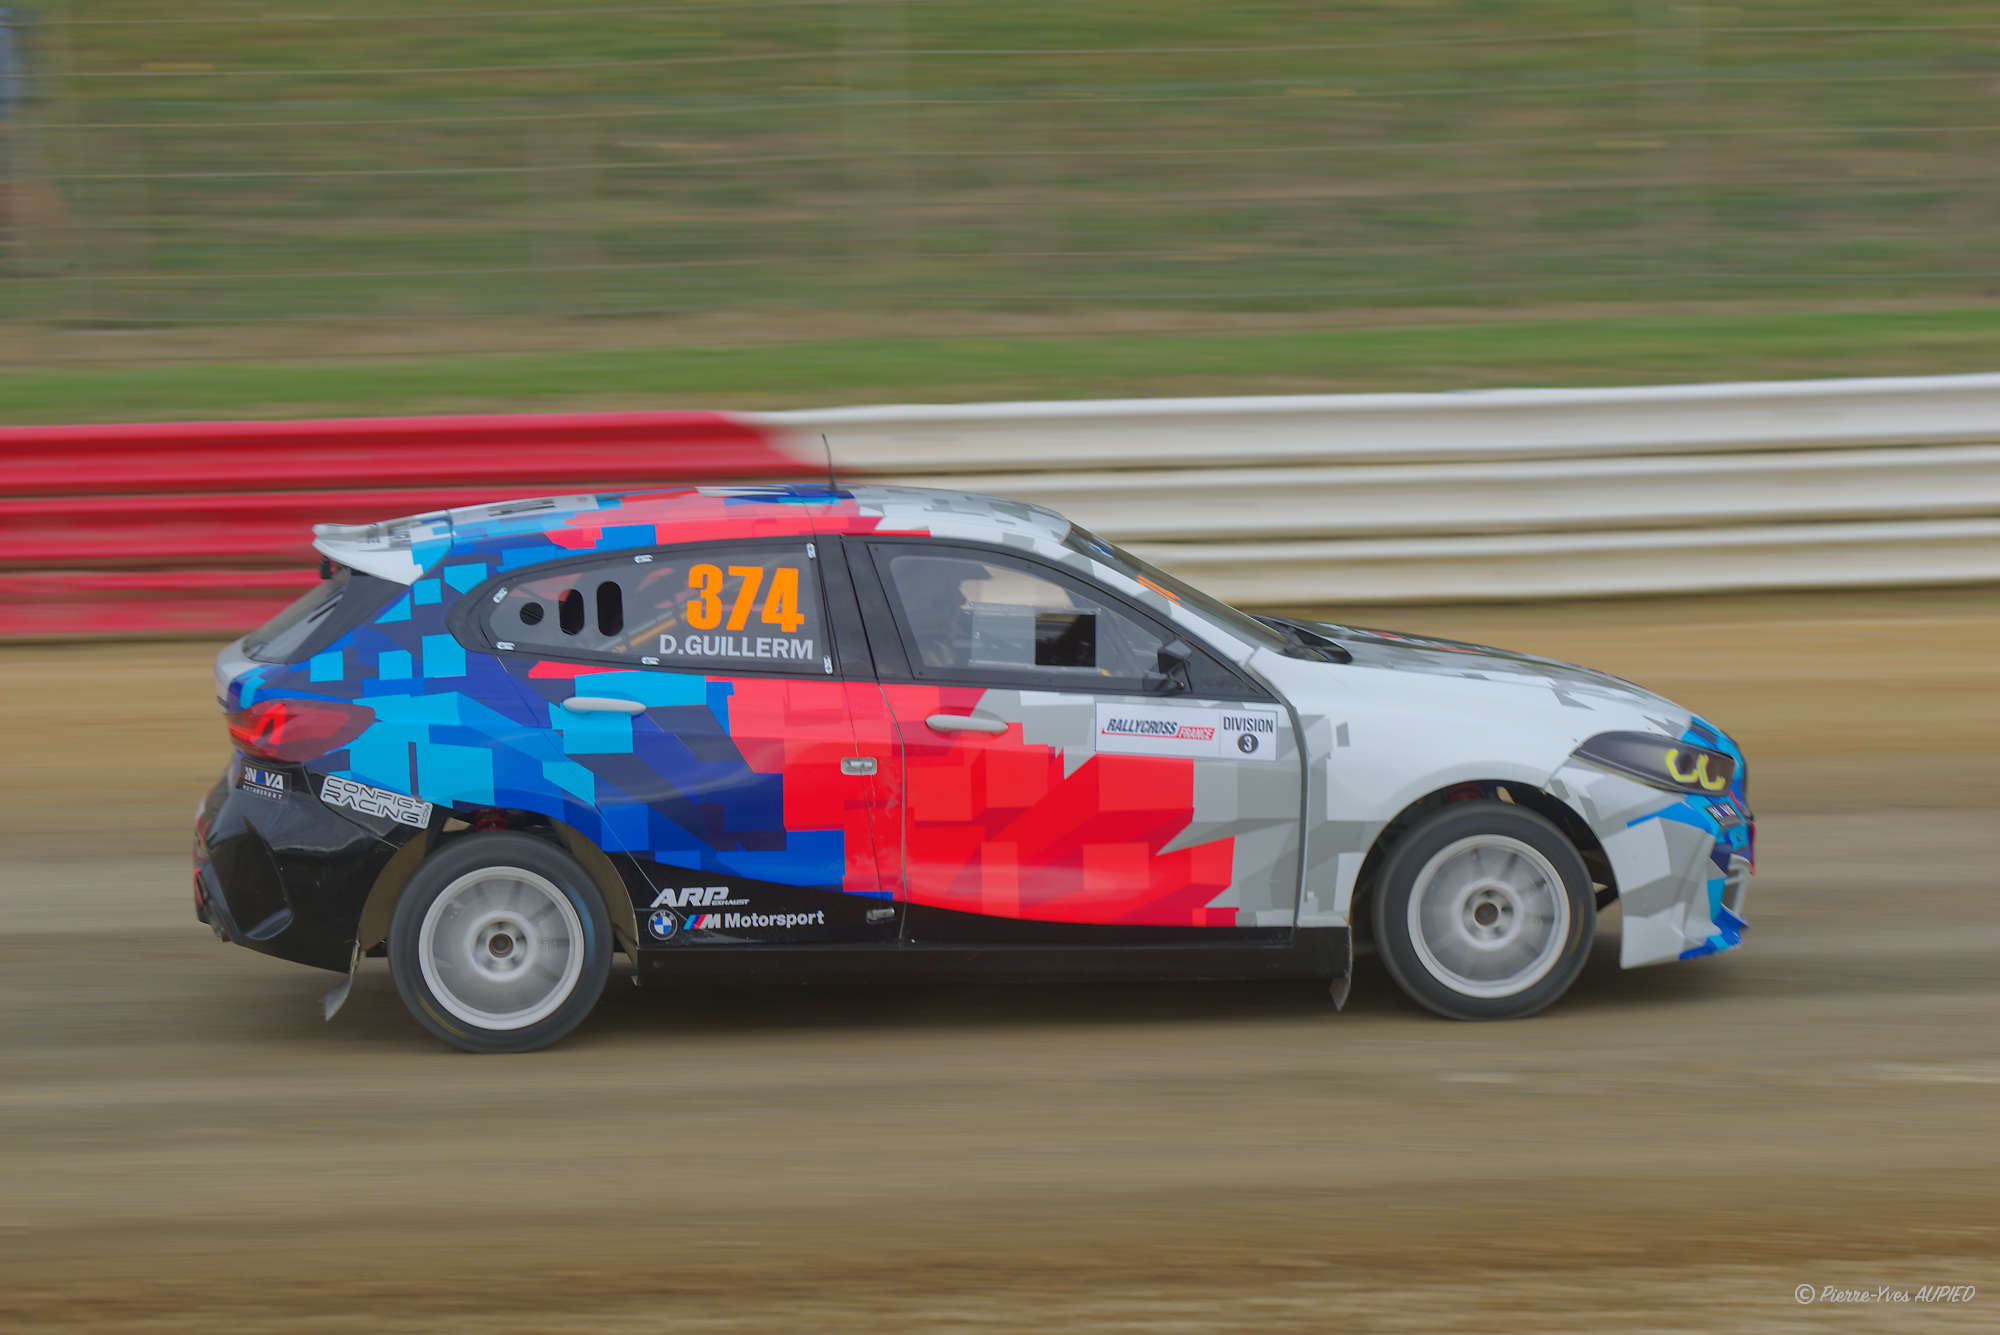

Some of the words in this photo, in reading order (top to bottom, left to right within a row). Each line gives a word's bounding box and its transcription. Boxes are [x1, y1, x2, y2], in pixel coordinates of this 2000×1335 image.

[686, 563, 805, 632] 374
[659, 634, 813, 660] D.GUILLERM
[1106, 718, 1177, 735] RALLYCROSS
[1223, 716, 1273, 733] DIVISION
[322, 790, 419, 824] RACING
[650, 886, 729, 908] ARP
[724, 910, 824, 929] Motorsport
